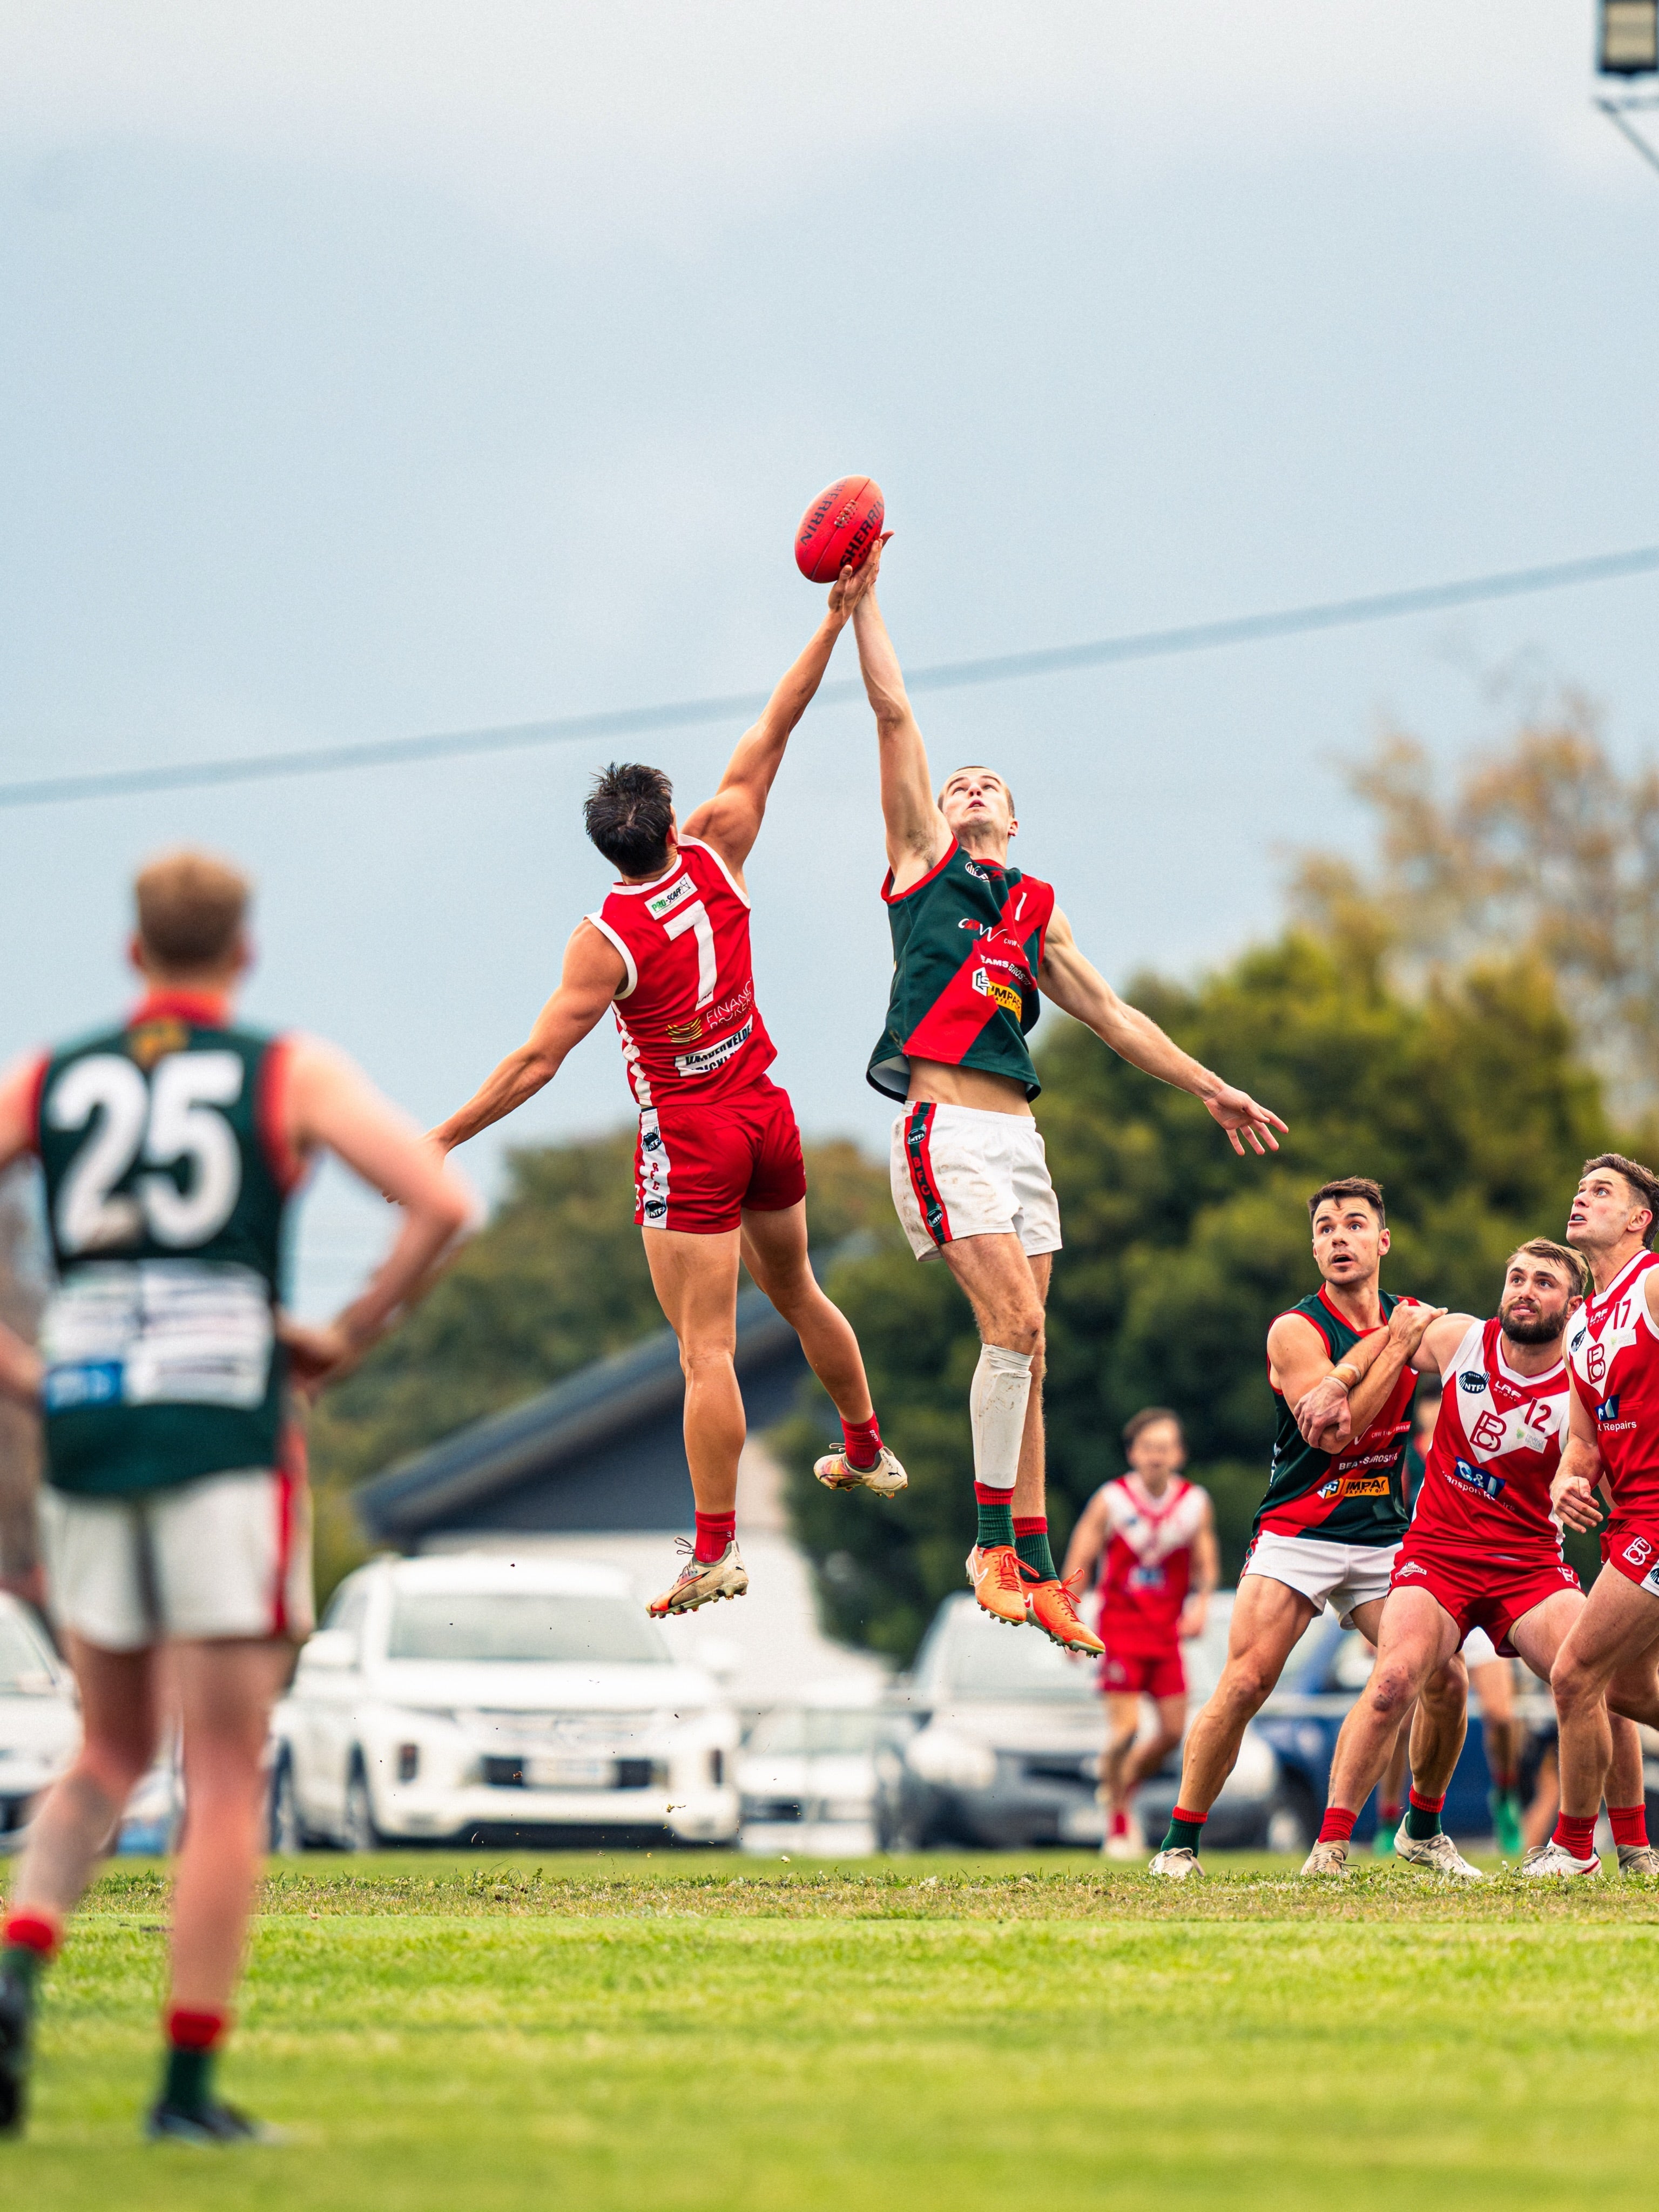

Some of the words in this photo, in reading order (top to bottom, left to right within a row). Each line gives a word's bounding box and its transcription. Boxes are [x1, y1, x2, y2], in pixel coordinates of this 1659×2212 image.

[651, 886, 682, 912] PRO-SCAFF
[663, 899, 717, 1011] 7
[980, 954, 1009, 968] EAMS
[706, 976, 752, 1023] FINANC
[48, 1050, 244, 1250] 25
[1614, 1298, 1631, 1330] 17
[1464, 1383, 1485, 1392] NTFA
[1524, 1398, 1552, 1433] 12
[1603, 1421, 1637, 1432] Repairs
[1339, 1456, 1370, 1471] BEAS
[1442, 1471, 1481, 1495] anspor
